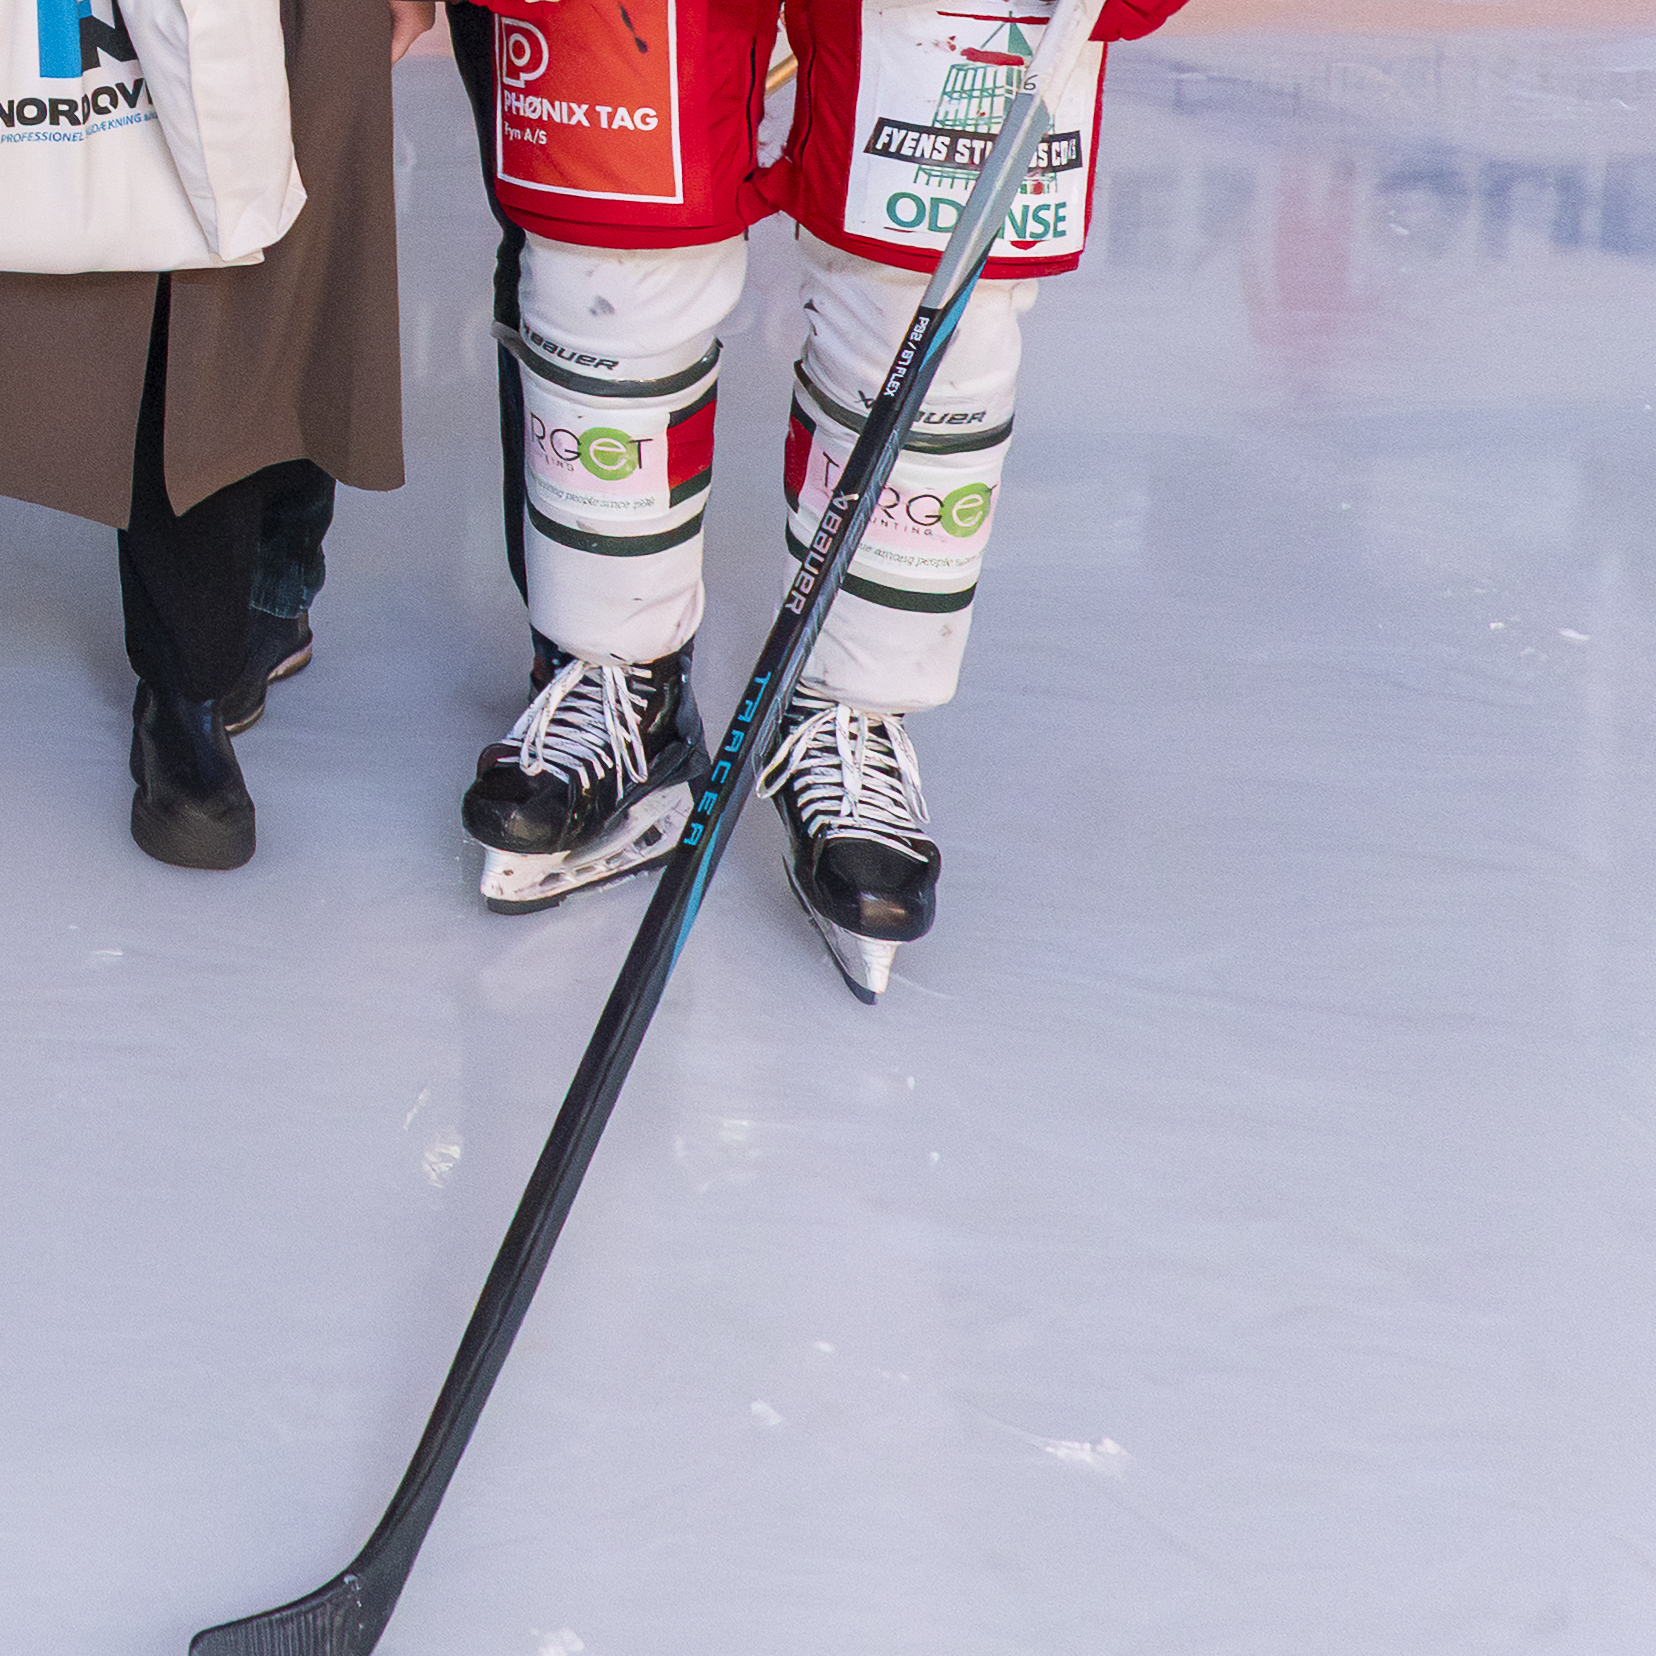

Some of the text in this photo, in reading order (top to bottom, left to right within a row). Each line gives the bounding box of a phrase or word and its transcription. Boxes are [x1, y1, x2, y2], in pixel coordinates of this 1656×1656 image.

[504, 89, 659, 132] PHØNIX TAG
[524, 128, 548, 146] A/S
[875, 125, 949, 161] FYENS
[886, 191, 1068, 239] ODNSE
[683, 670, 772, 847] TRACER
